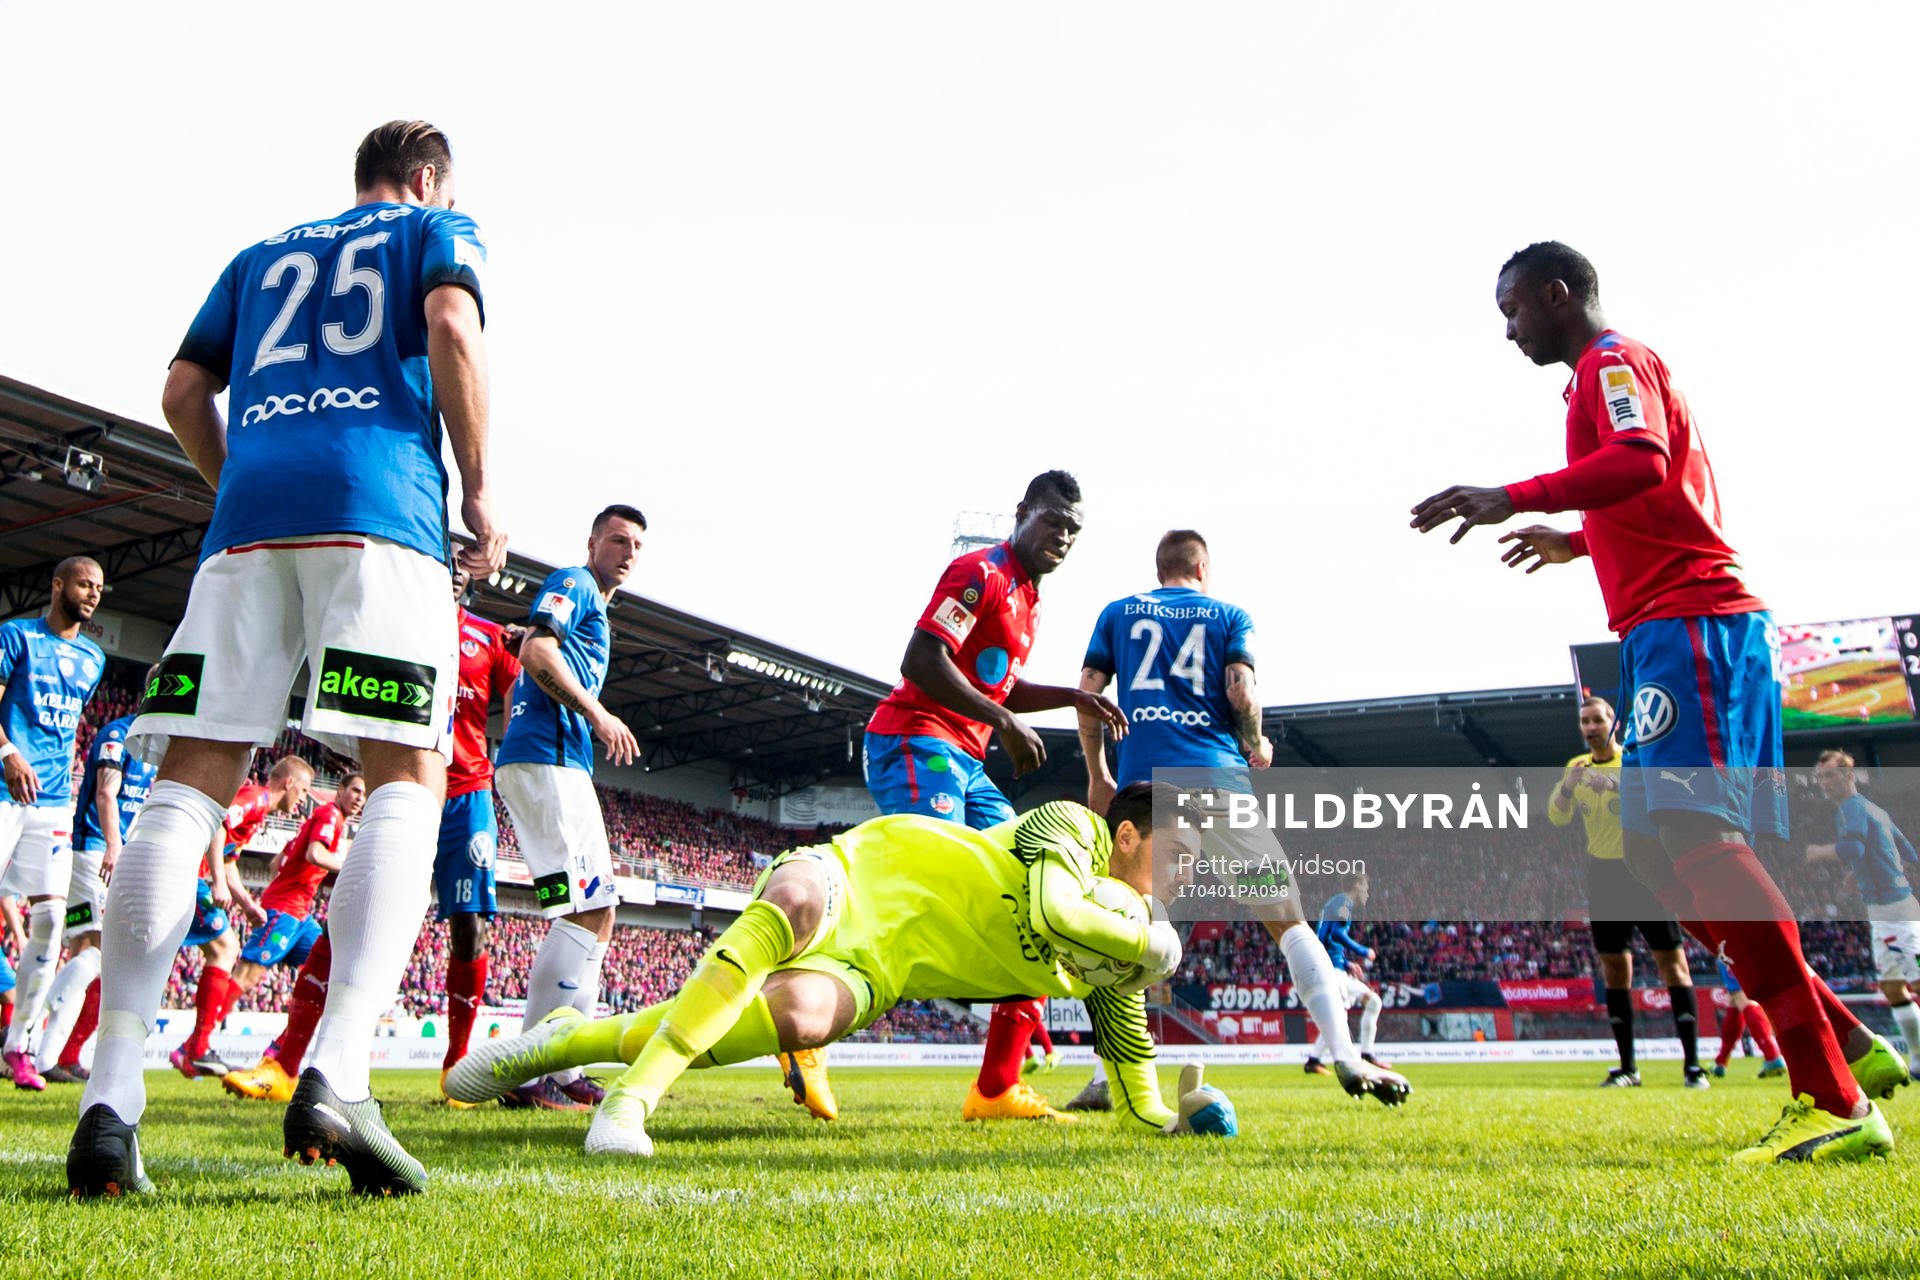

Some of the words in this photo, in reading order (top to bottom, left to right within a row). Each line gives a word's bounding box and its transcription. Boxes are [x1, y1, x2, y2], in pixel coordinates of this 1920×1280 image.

[249, 231, 393, 376] 25
[1124, 603, 1220, 620] ERIKSBERG
[1129, 618, 1207, 697] 24
[320, 666, 399, 703] akea
[455, 878, 473, 904] 18
[1210, 985, 1280, 1011] SÖDRA
